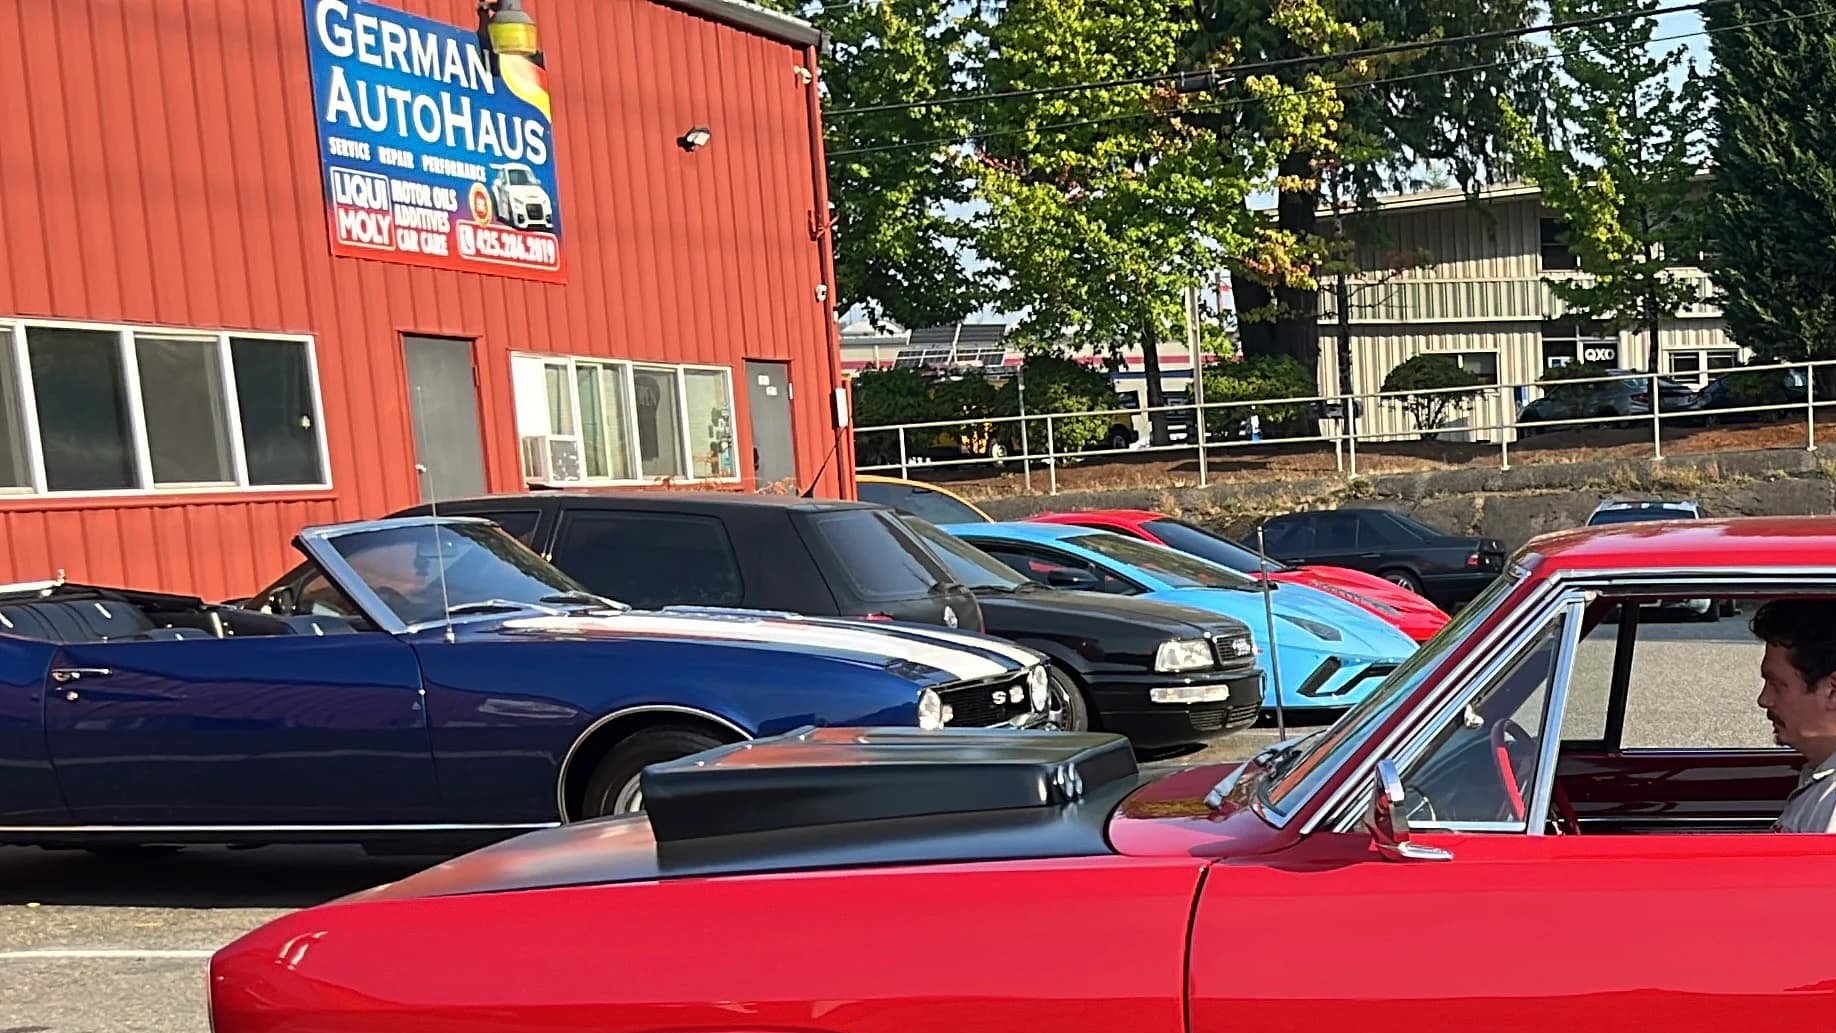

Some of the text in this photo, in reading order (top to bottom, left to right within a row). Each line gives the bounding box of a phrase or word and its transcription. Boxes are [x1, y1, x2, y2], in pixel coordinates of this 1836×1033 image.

[317, 0, 494, 94] GERMAN
[326, 66, 547, 165] AUTOHAUS
[329, 137, 486, 182] SERVICE REPAIR PERFORMANCE
[335, 172, 389, 211] LIQUI
[391, 179, 431, 206] MOTOR
[433, 186, 458, 212] OILS
[338, 208, 391, 244] MOLY
[394, 204, 450, 233] ADDITIVES
[397, 228, 448, 256] CAR CARE
[1585, 348, 1615, 362] QXO
